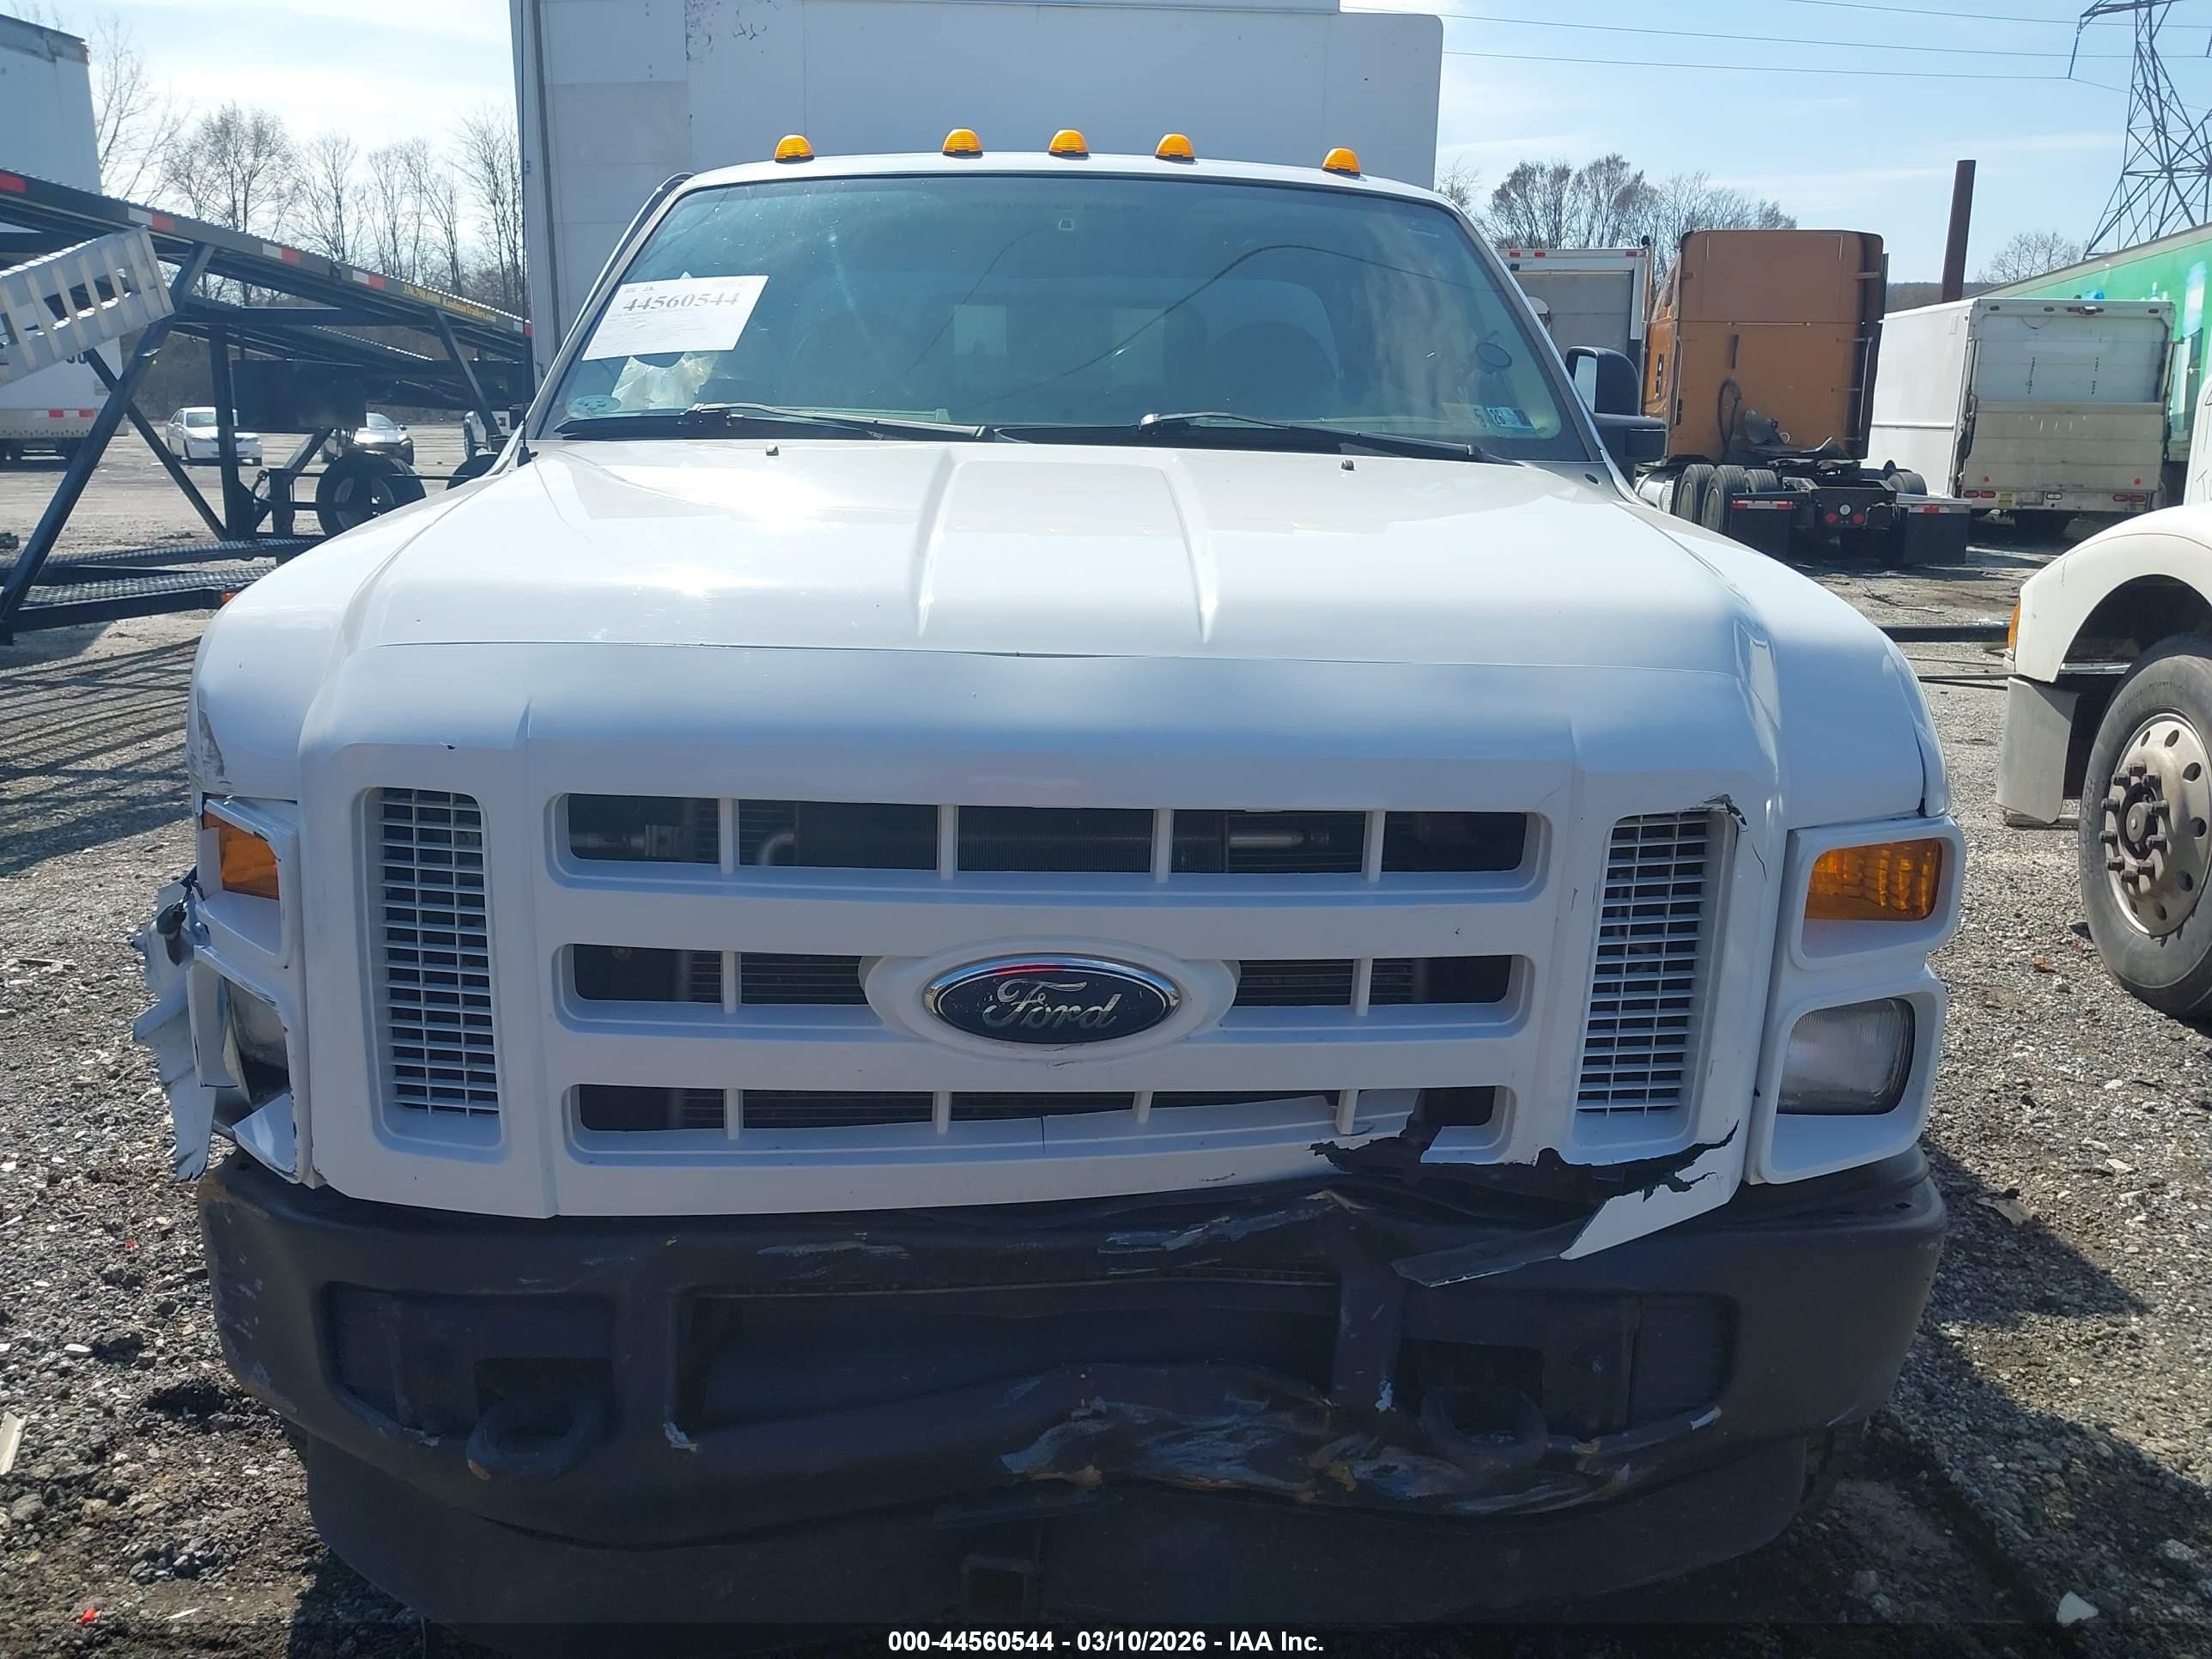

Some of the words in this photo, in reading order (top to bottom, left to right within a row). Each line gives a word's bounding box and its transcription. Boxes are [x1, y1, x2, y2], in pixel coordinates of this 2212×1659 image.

[623, 292, 740, 312] 44560544
[1489, 409, 1506, 425] 26
[982, 978, 1122, 1029] Ford
